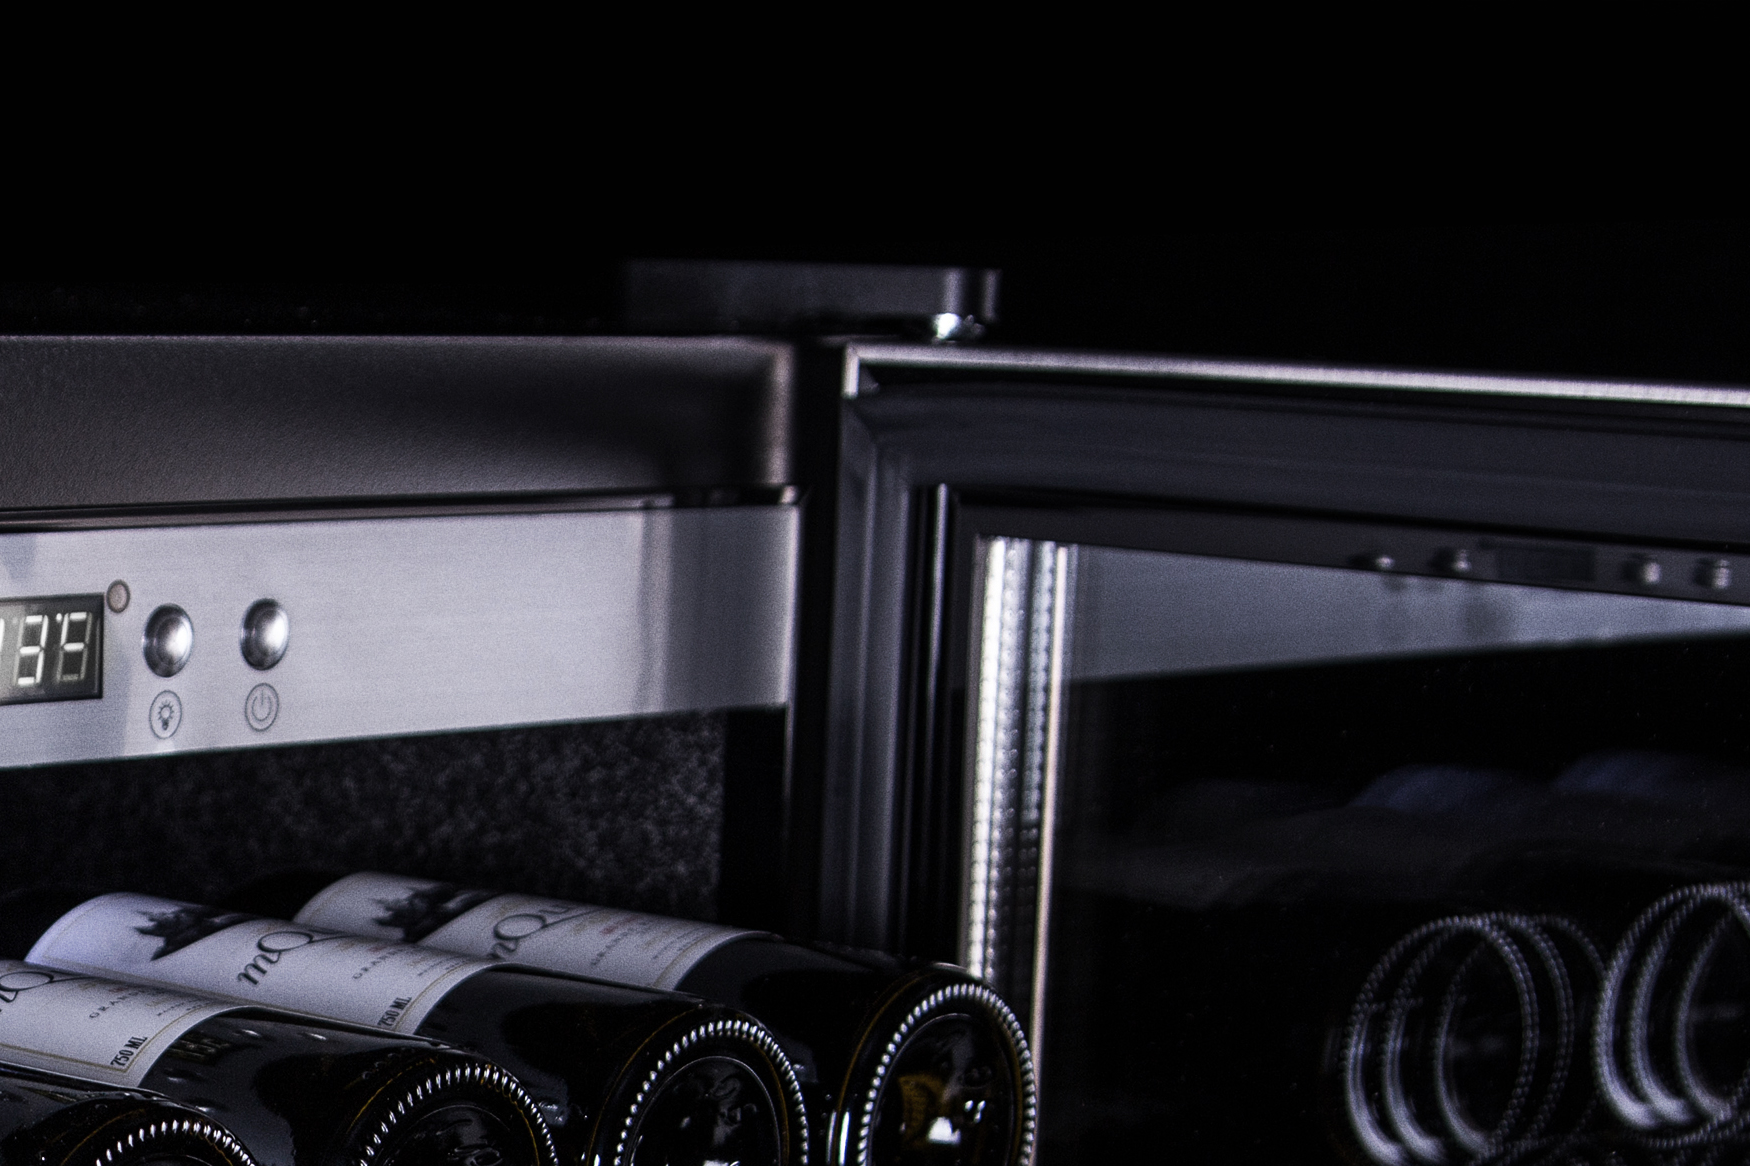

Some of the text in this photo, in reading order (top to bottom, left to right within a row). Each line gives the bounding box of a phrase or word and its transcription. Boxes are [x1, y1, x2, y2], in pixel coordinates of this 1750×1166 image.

[377, 996, 413, 1028] 750 ML
[109, 1035, 149, 1068] 750 ML
